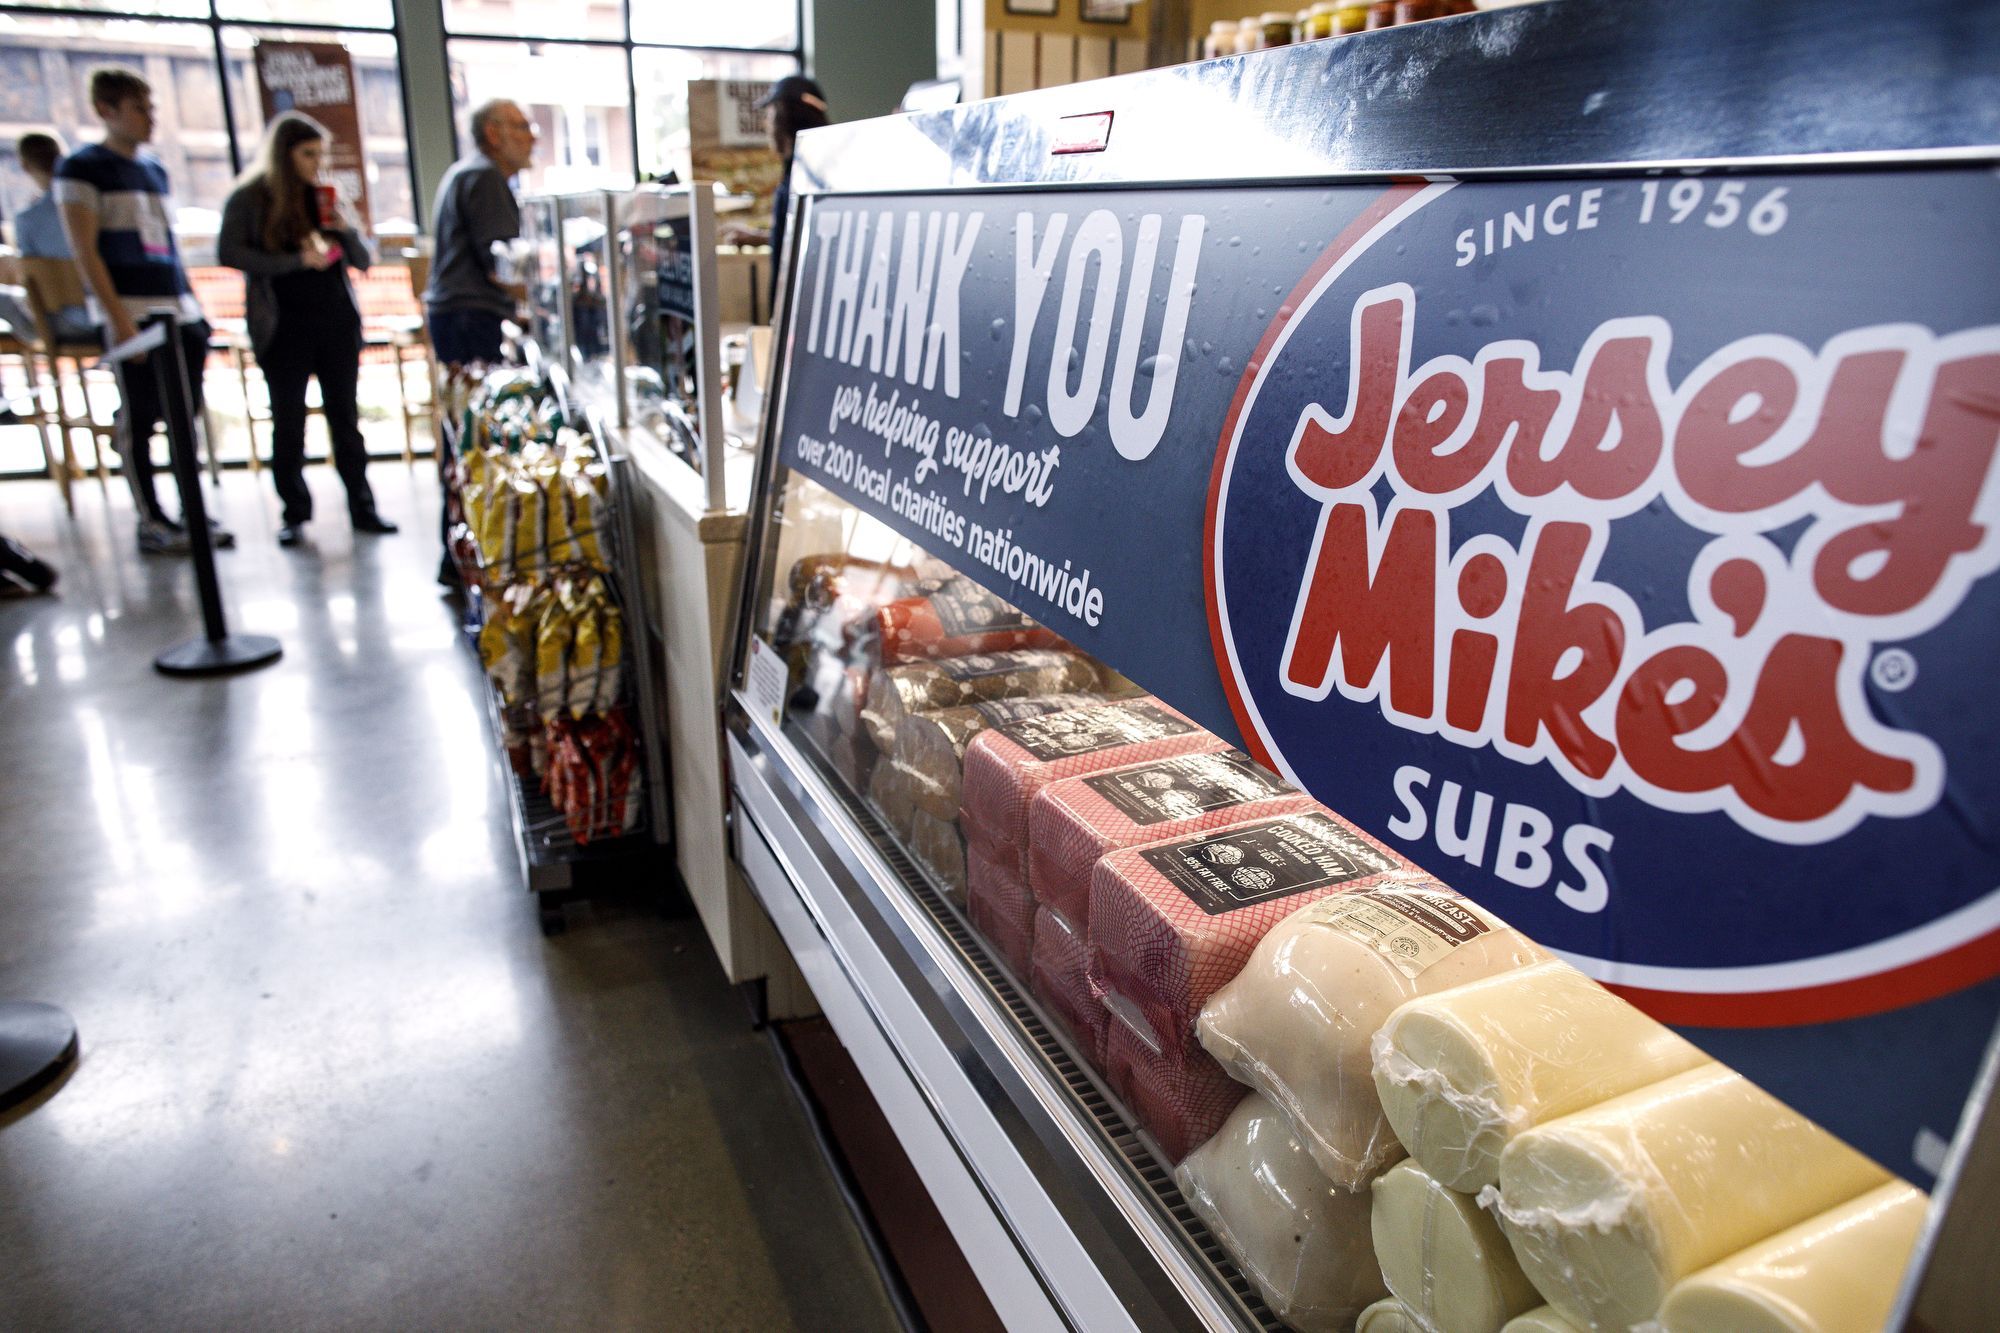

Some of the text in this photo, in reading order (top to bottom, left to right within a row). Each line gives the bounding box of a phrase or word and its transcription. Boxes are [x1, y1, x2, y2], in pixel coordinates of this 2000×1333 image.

[1455, 178, 1791, 267] SINCE 1956
[806, 209, 1205, 461] THANK YOU
[829, 382, 1060, 508] for helping support
[1288, 285, 2000, 626] Jersey
[797, 433, 826, 467] over
[824, 441, 854, 483] 200
[853, 454, 892, 505] local
[891, 478, 966, 548] charities
[967, 522, 1104, 627] nationwide
[1284, 502, 1930, 832] Mike's
[1183, 857, 1232, 892] 95% FAT FREE
[1266, 825, 1324, 855] COOKED
[1312, 854, 1348, 876] HAM
[1387, 765, 1615, 913] SUBS
[1422, 895, 1476, 924] BREAST
